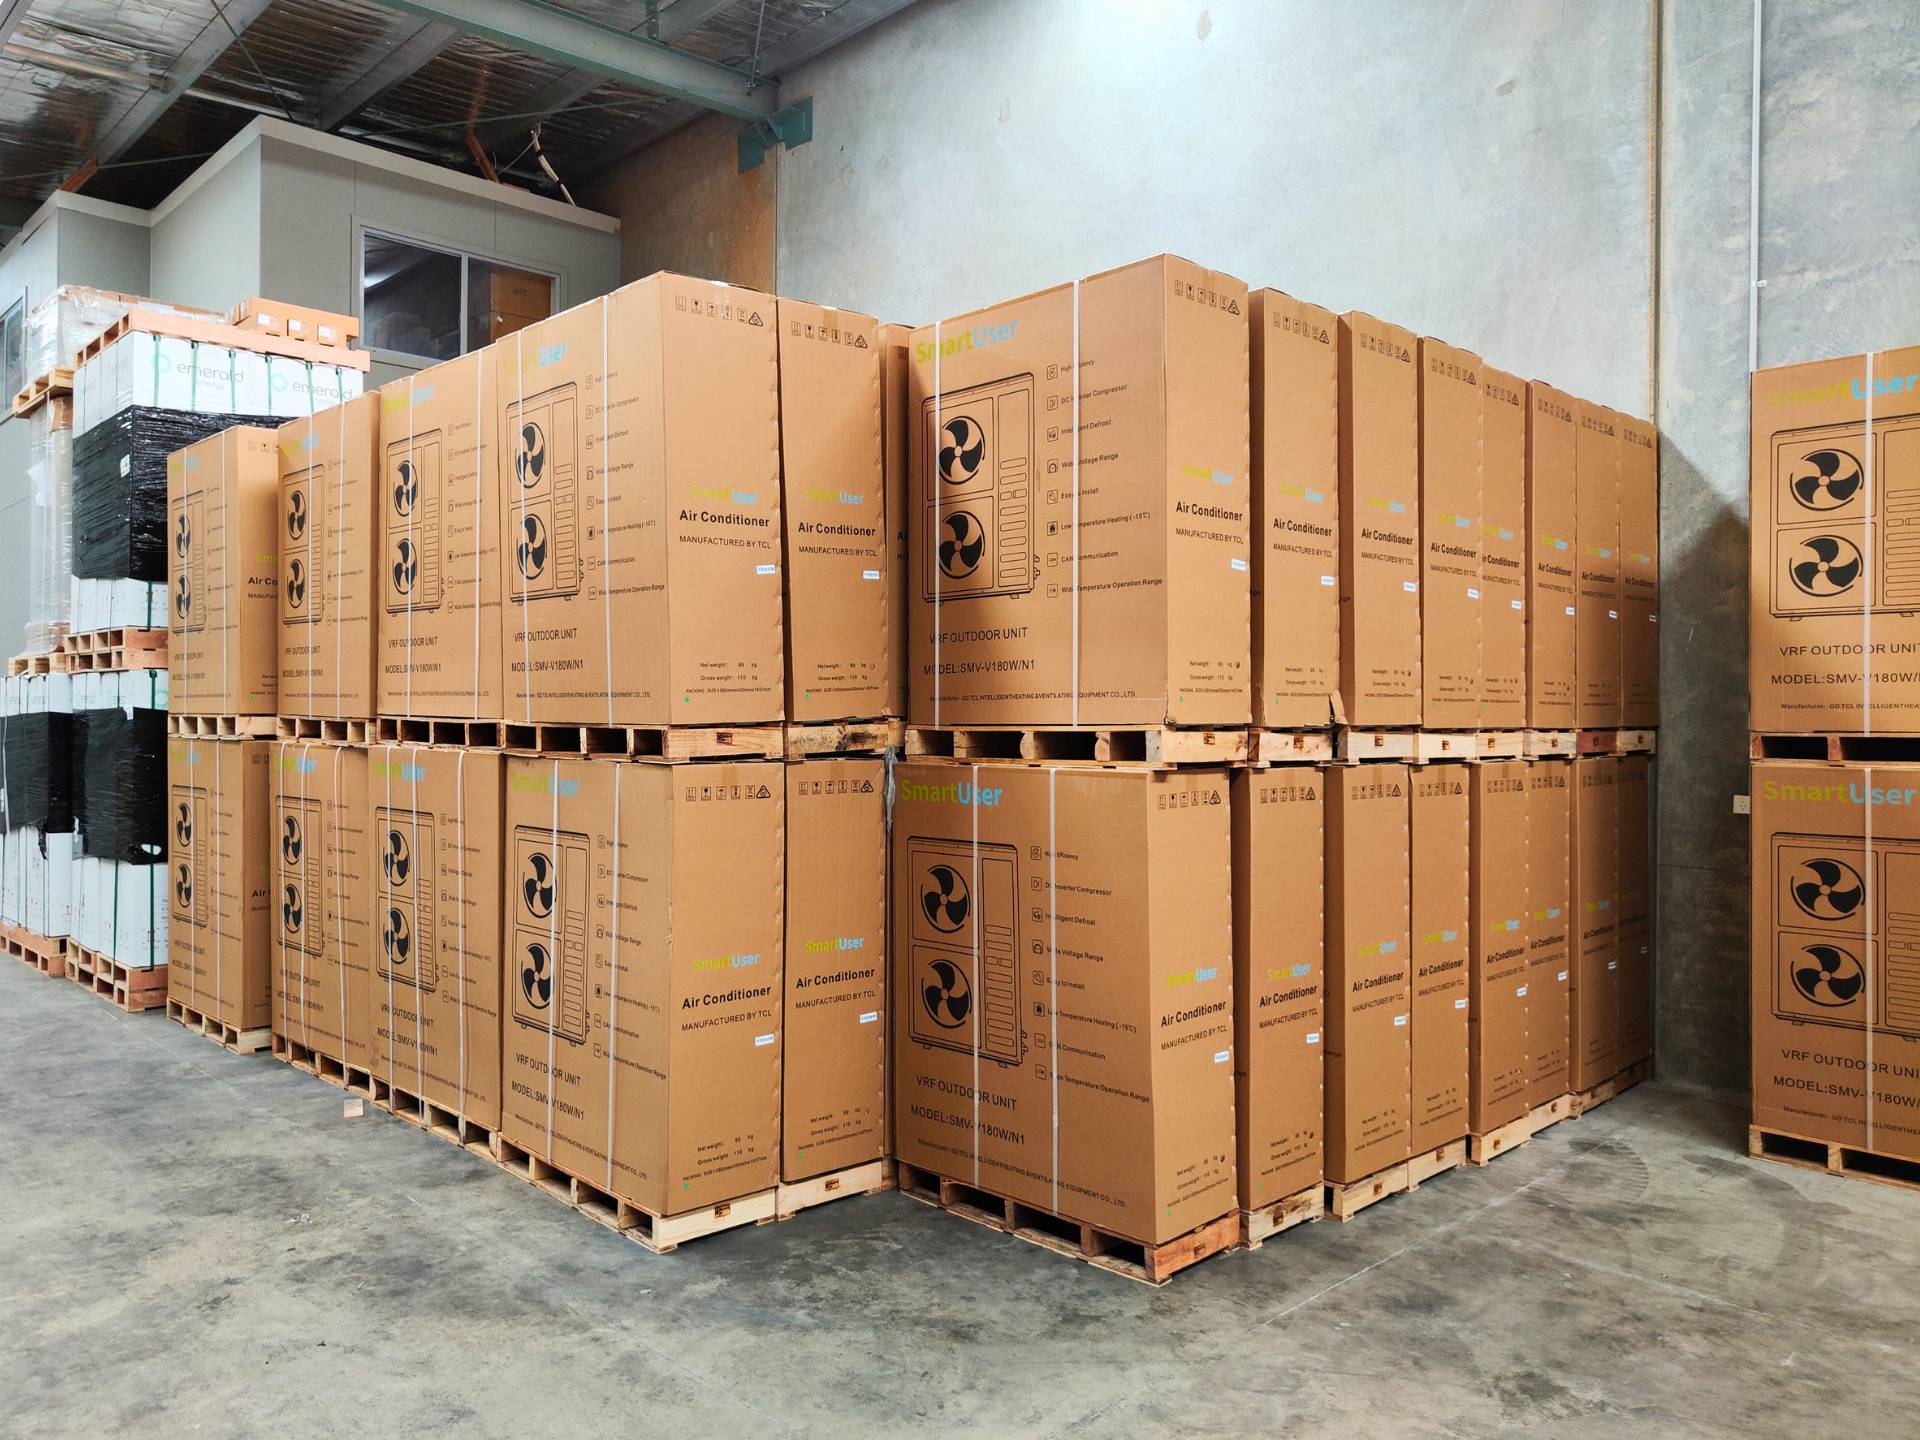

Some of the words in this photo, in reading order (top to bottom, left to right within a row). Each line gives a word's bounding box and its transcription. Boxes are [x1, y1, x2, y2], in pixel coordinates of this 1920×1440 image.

[916, 319, 1018, 365] SmartUser
[292, 382, 352, 400] emerad
[1061, 396, 1069, 404] DC
[1093, 385, 1127, 396] Compressor
[1090, 419, 1111, 429] Defrost
[680, 510, 698, 521] Air
[700, 511, 770, 528] Conditioner
[1176, 501, 1189, 513] Air
[1191, 503, 1243, 521] Conditioner
[798, 522, 813, 533] Air
[816, 523, 876, 537] Conditioner
[1175, 528, 1223, 542] MANUFACTURED
[1225, 534, 1232, 542] BY
[1233, 536, 1244, 544] TCL
[1273, 518, 1285, 529] Air
[1287, 520, 1332, 537] Conditioner
[679, 535, 745, 547] MANUFACTURED
[746, 539, 756, 548] BY
[757, 540, 772, 549] TCL
[1361, 528, 1372, 539] Air
[1373, 530, 1413, 546] Conditioner
[799, 546, 854, 556] MANUFACTURED
[865, 549, 877, 557] TCL
[1075, 551, 1118, 561] ommunication
[1273, 543, 1315, 556] MANUFACTURED
[1316, 549, 1322, 557] BY
[1323, 550, 1332, 558] TCL
[1431, 542, 1441, 553] Air
[1441, 543, 1477, 558] Conditioner
[248, 577, 262, 585] Air
[1113, 580, 1140, 588] Operation
[425, 636, 438, 647] UNIT
[527, 629, 559, 642] OUTDOOR
[561, 628, 577, 639] UNIT
[930, 633, 948, 644] VRF
[950, 630, 1000, 643] OUTDOOR
[1003, 627, 1027, 639] UNIT
[1779, 646, 1807, 656] VRF
[512, 659, 584, 672] MODL:SMV-V180W/N1
[1771, 673, 1920, 684] MODEL:SMV-180W/
[902, 779, 1003, 806] SmartUser
[1763, 780, 1918, 805] SmartUser
[252, 889, 266, 898] Air
[1077, 886, 1111, 895] Compressor
[1075, 917, 1096, 926] Defrost
[804, 936, 865, 954] SmartUser
[1530, 940, 1538, 950] Air
[692, 952, 760, 972] SmartUser
[1085, 952, 1103, 962] Range
[1487, 953, 1495, 965] Air
[1495, 947, 1525, 963] Conditioner
[1418, 967, 1429, 977] Air
[1429, 959, 1464, 974] Conditioner
[796, 977, 812, 989] Air
[814, 968, 875, 986] Conditioner
[1352, 980, 1363, 993] Air
[1364, 971, 1404, 989] Conditioner
[682, 998, 700, 1009] Air
[703, 985, 772, 1006] Conditioner
[795, 994, 852, 1009] MANUFACTURED
[853, 992, 862, 1000] BY
[863, 989, 876, 998] TCL
[1259, 995, 1271, 1008] Air
[1273, 985, 1317, 1003] Conditioner
[682, 1014, 745, 1032] MANUFACTURED
[746, 1012, 757, 1021] BY
[758, 1009, 772, 1018] TCL
[1060, 1010, 1092, 1023] Temperature
[1094, 1018, 1115, 1030] Heating
[1161, 1014, 1174, 1028] Air
[1176, 1000, 1227, 1022] Conditioner
[1259, 1012, 1301, 1029] MANUFACTURED
[1301, 1010, 1308, 1019] BY
[1308, 1008, 1318, 1016] TCL
[1161, 1029, 1208, 1050] MANUFACTURED
[1209, 1028, 1216, 1037] BY
[1217, 1025, 1227, 1033] TCL
[1062, 1043, 1106, 1060] Communication
[516, 1052, 529, 1066] VRF
[530, 1058, 563, 1080] OUTDOR
[564, 1073, 581, 1087] UNIT
[1782, 1048, 1810, 1059] VRF
[1894, 1065, 1920, 1078] UNI
[916, 1075, 936, 1088] VRF
[992, 1094, 1017, 1110] UNIT
[1064, 1075, 1099, 1090] Temperature
[1100, 1085, 1128, 1097] Operation
[1130, 1092, 1150, 1103] Range
[512, 1080, 584, 1121] MODEL:SMVV180W/N1
[1066, 1182, 1100, 1198] EQUIPMENT
